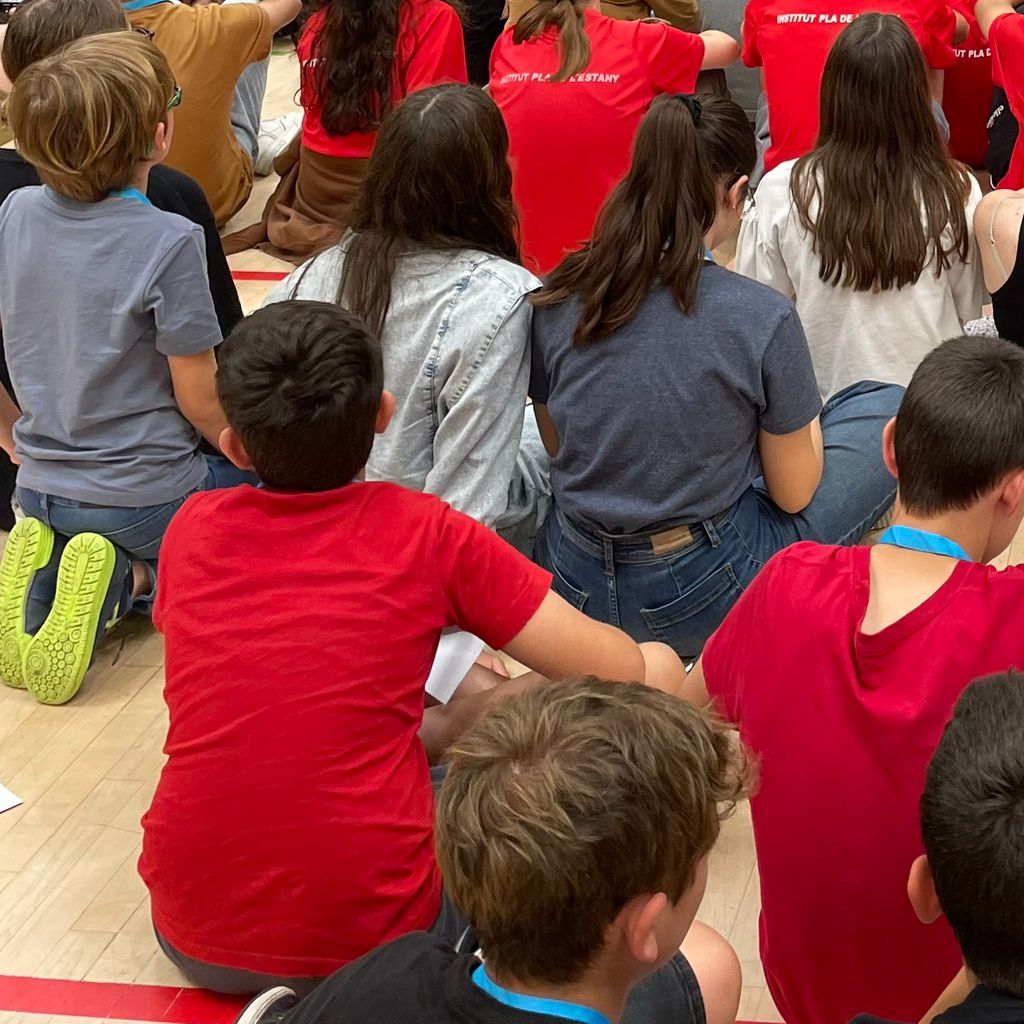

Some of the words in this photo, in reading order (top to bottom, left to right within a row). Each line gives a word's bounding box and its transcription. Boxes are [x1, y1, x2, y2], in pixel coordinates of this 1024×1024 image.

[776, 13, 816, 24] INSTITUT
[819, 14, 838, 23] PLA
[839, 14, 853, 23] DE
[968, 49, 984, 58] PLA
